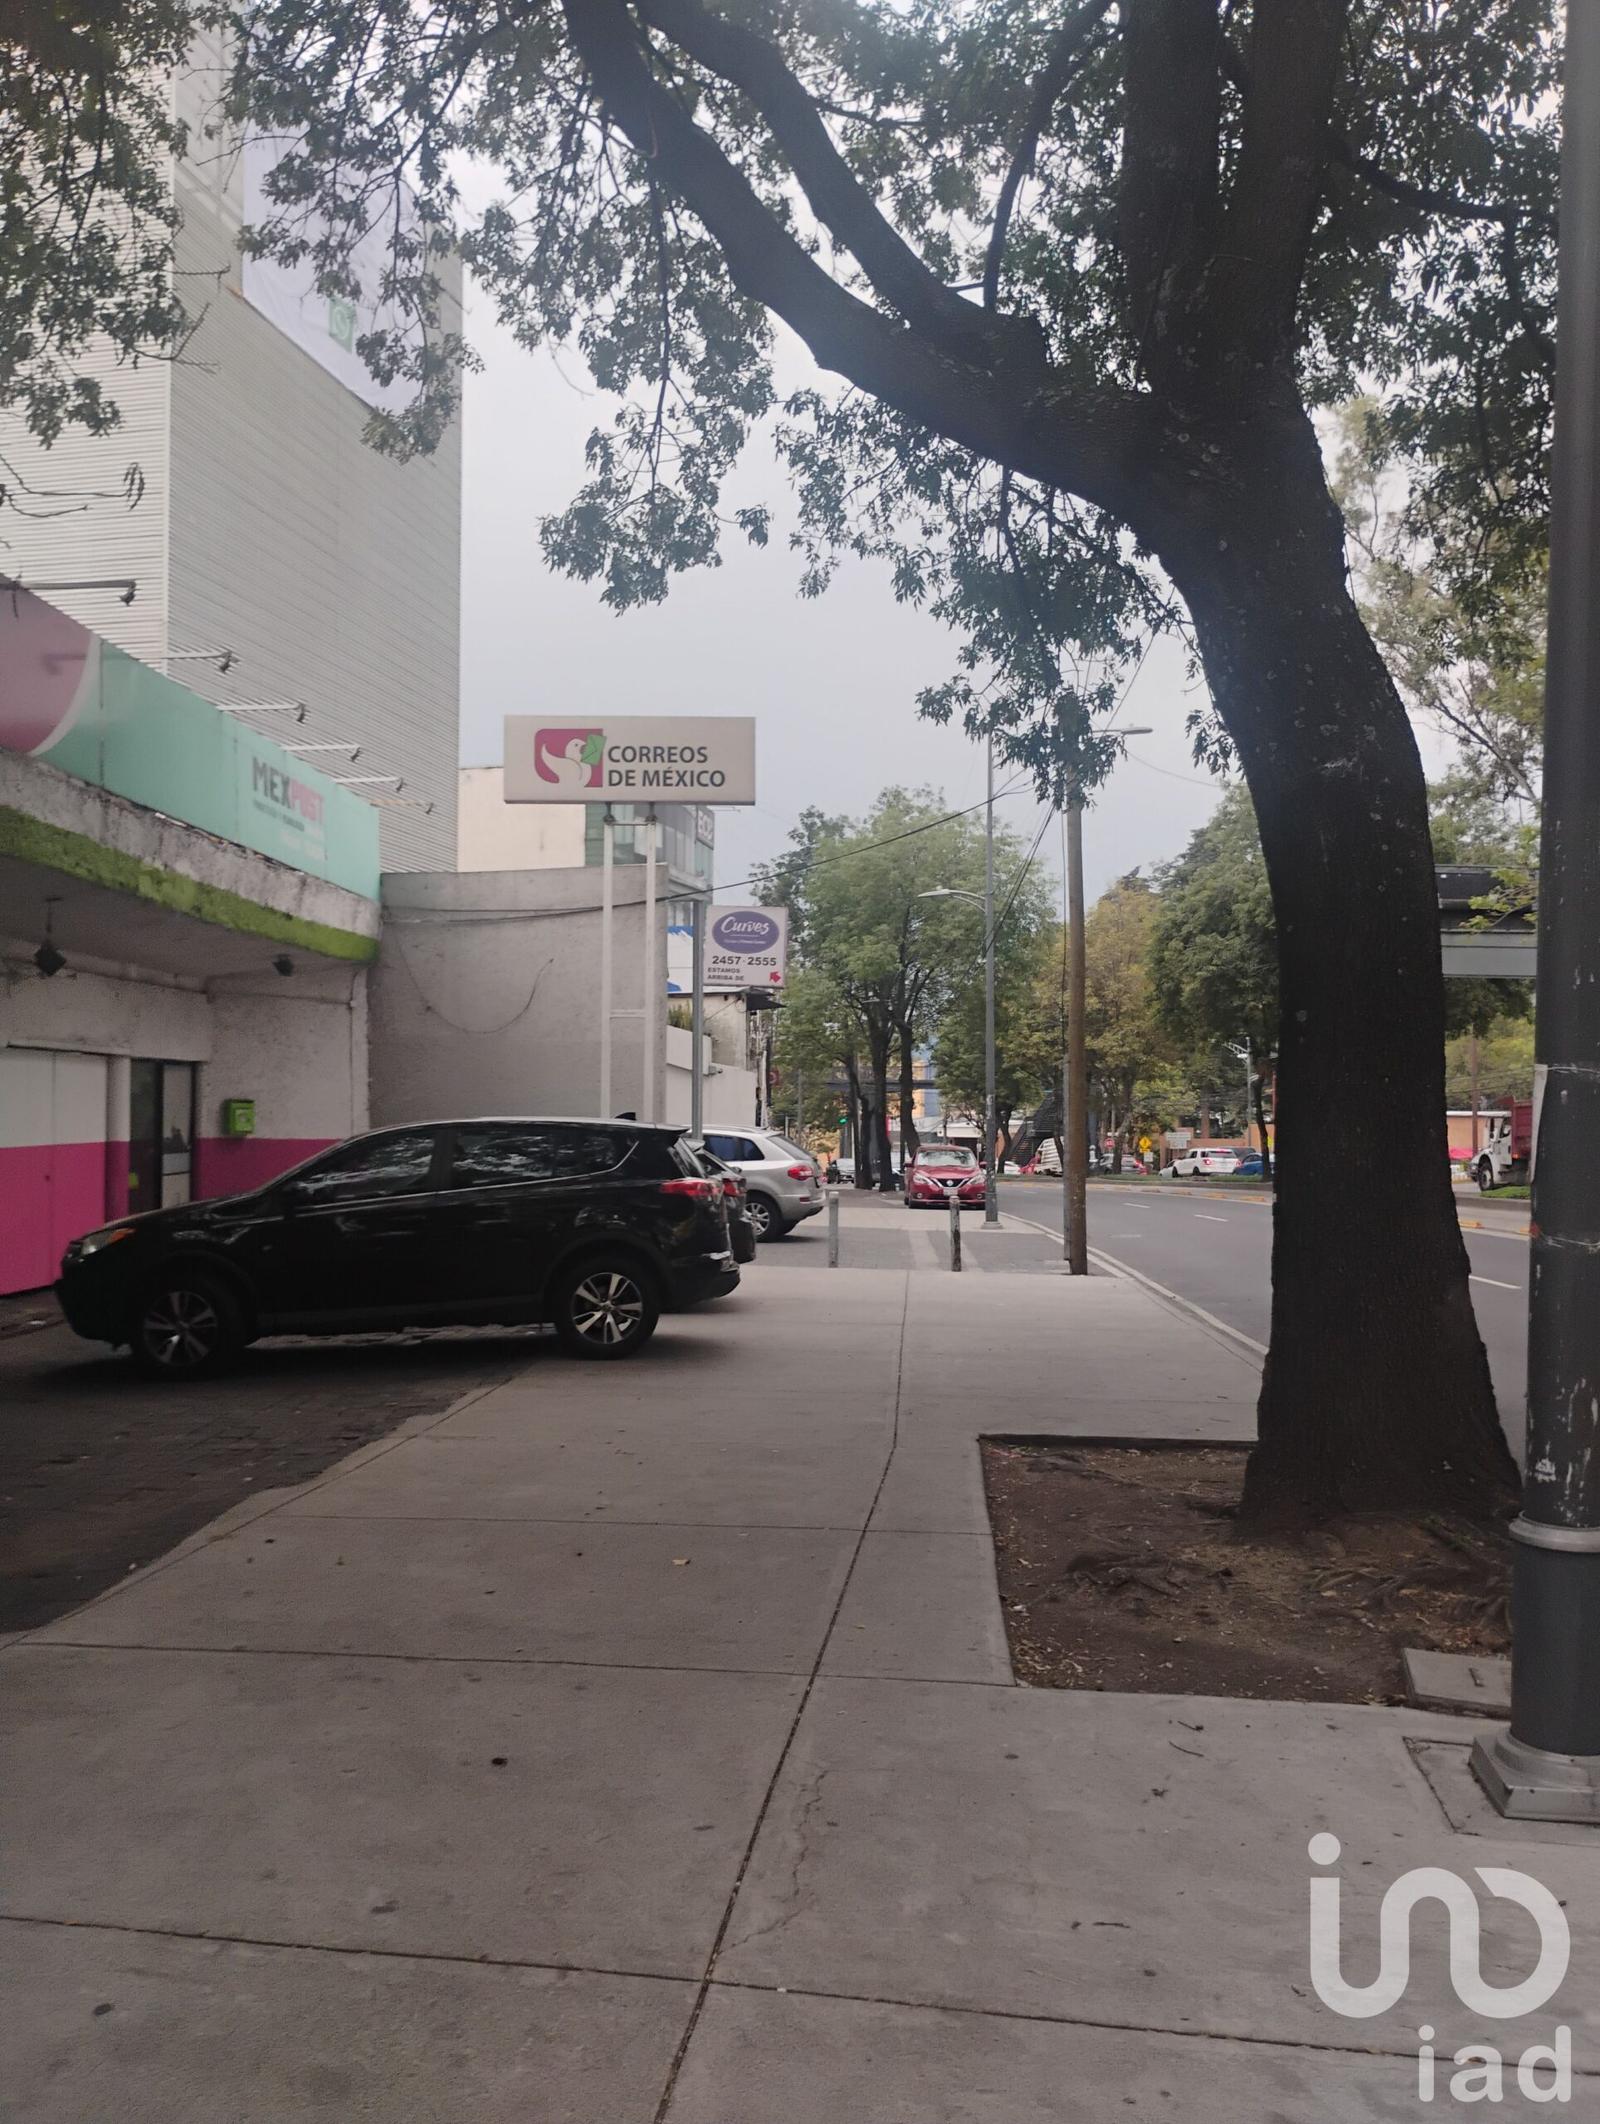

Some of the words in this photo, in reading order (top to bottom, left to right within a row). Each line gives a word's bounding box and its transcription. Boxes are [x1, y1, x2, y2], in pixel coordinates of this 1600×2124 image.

[608, 745, 708, 763] CORREOS
[608, 770, 636, 787] DE
[642, 767, 726, 787] MÉXICO
[720, 916, 769, 935] Curves
[712, 955, 741, 965] 2457
[747, 957, 777, 966] 2555
